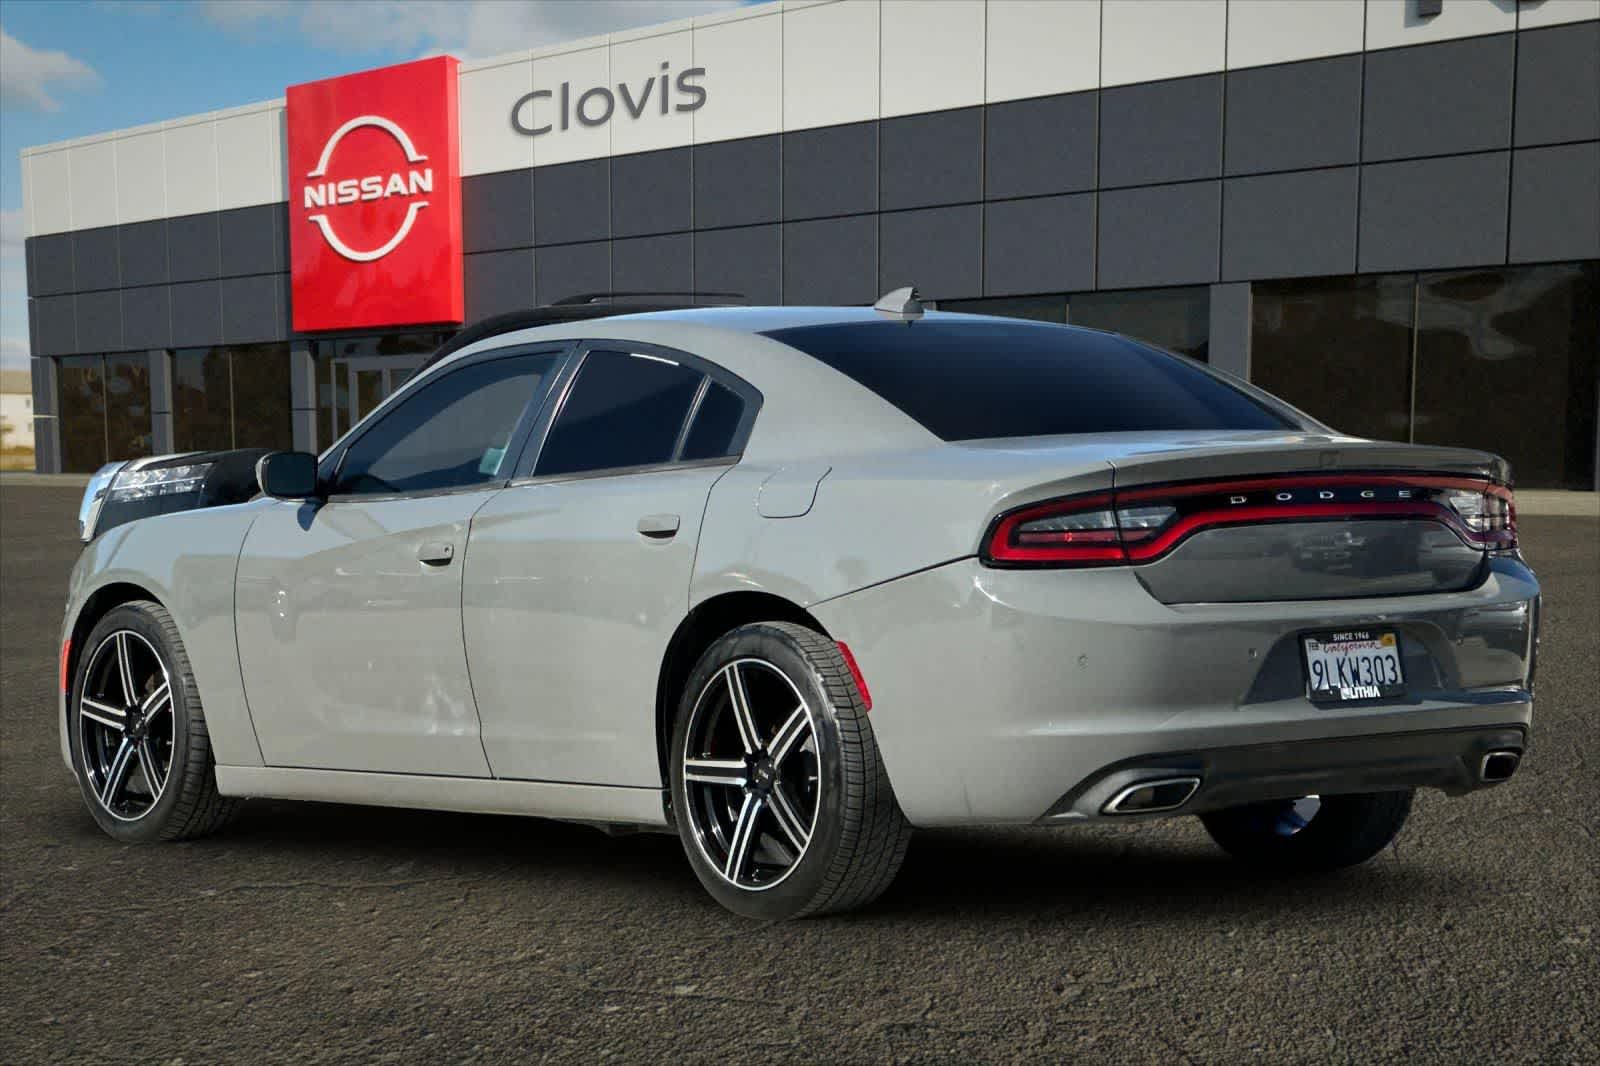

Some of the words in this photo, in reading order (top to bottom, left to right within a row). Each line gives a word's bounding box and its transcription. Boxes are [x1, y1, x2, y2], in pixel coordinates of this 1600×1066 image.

[511, 62, 707, 136] Clovis
[304, 168, 433, 208] NISSAN
[1231, 489, 1411, 504] DODGE
[1323, 641, 1381, 656] California
[1333, 632, 1353, 641] SINCE
[1312, 655, 1398, 690] 9LKW303
